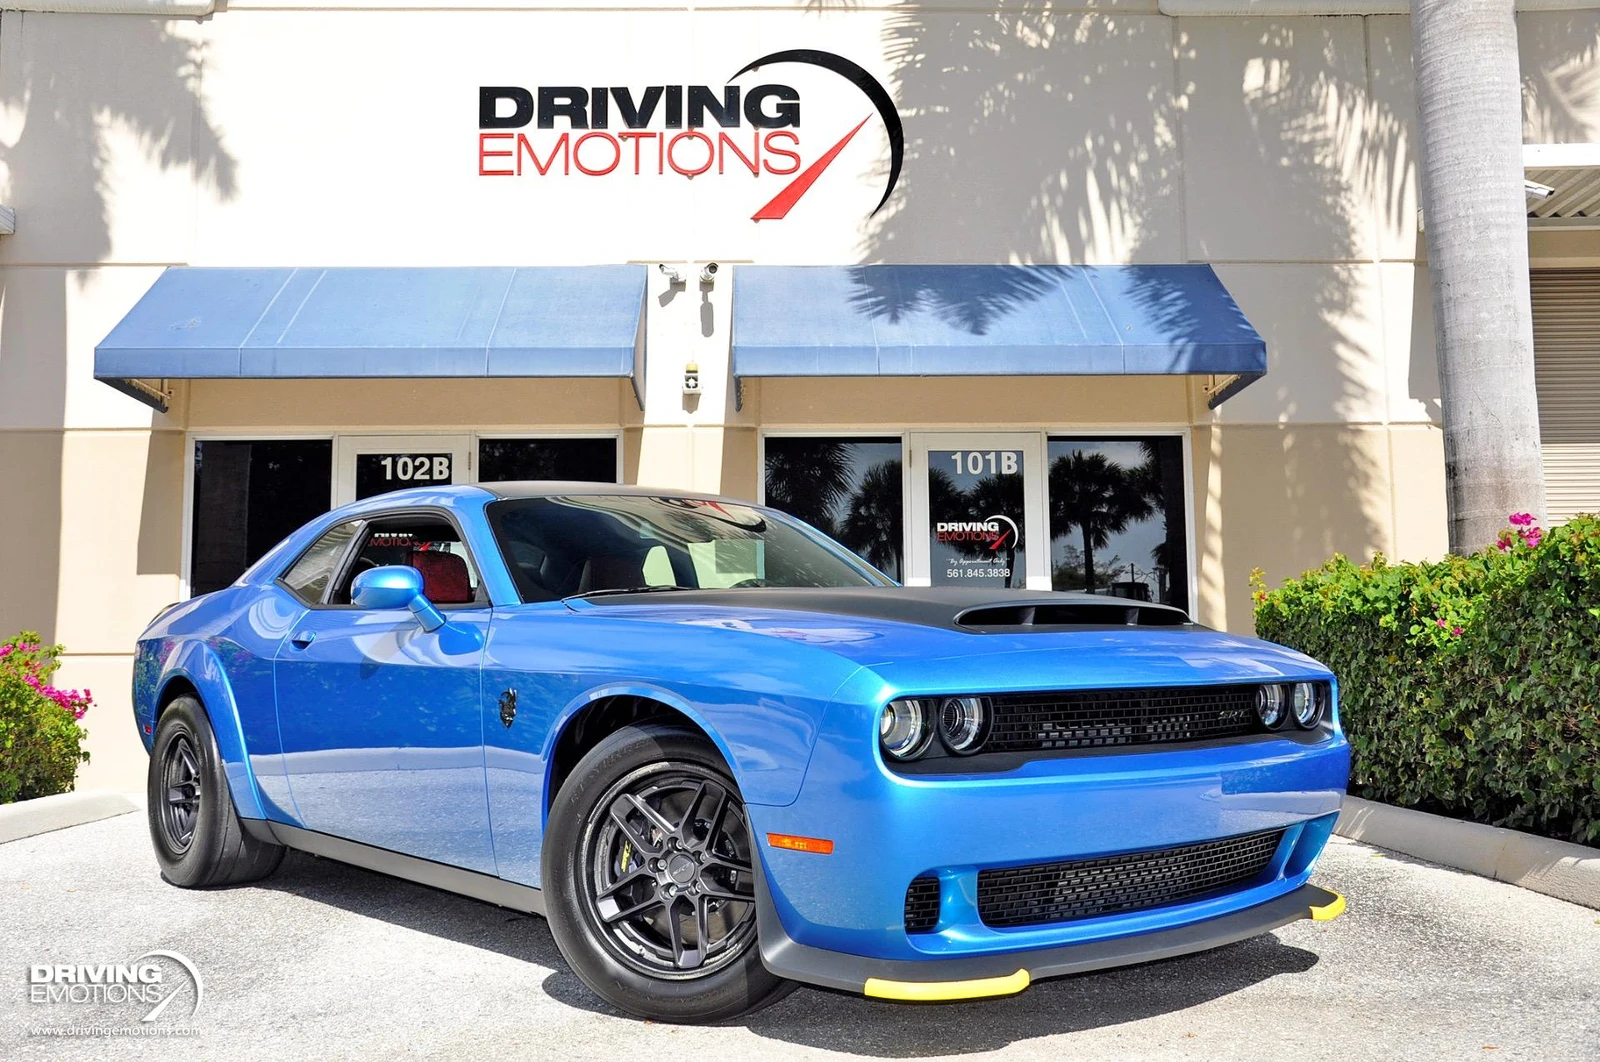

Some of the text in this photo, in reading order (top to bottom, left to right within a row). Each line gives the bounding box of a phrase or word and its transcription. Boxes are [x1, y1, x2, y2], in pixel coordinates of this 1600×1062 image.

[479, 84, 800, 129] DRIVING
[479, 131, 801, 176] EMOTIONS
[381, 456, 450, 480] 102B
[951, 452, 1018, 475] 101B
[937, 522, 999, 532] DRIVING
[937, 532, 1000, 541] EMOTIONS
[959, 558, 992, 566] Appointment
[947, 568, 1011, 578] 561.845.3838
